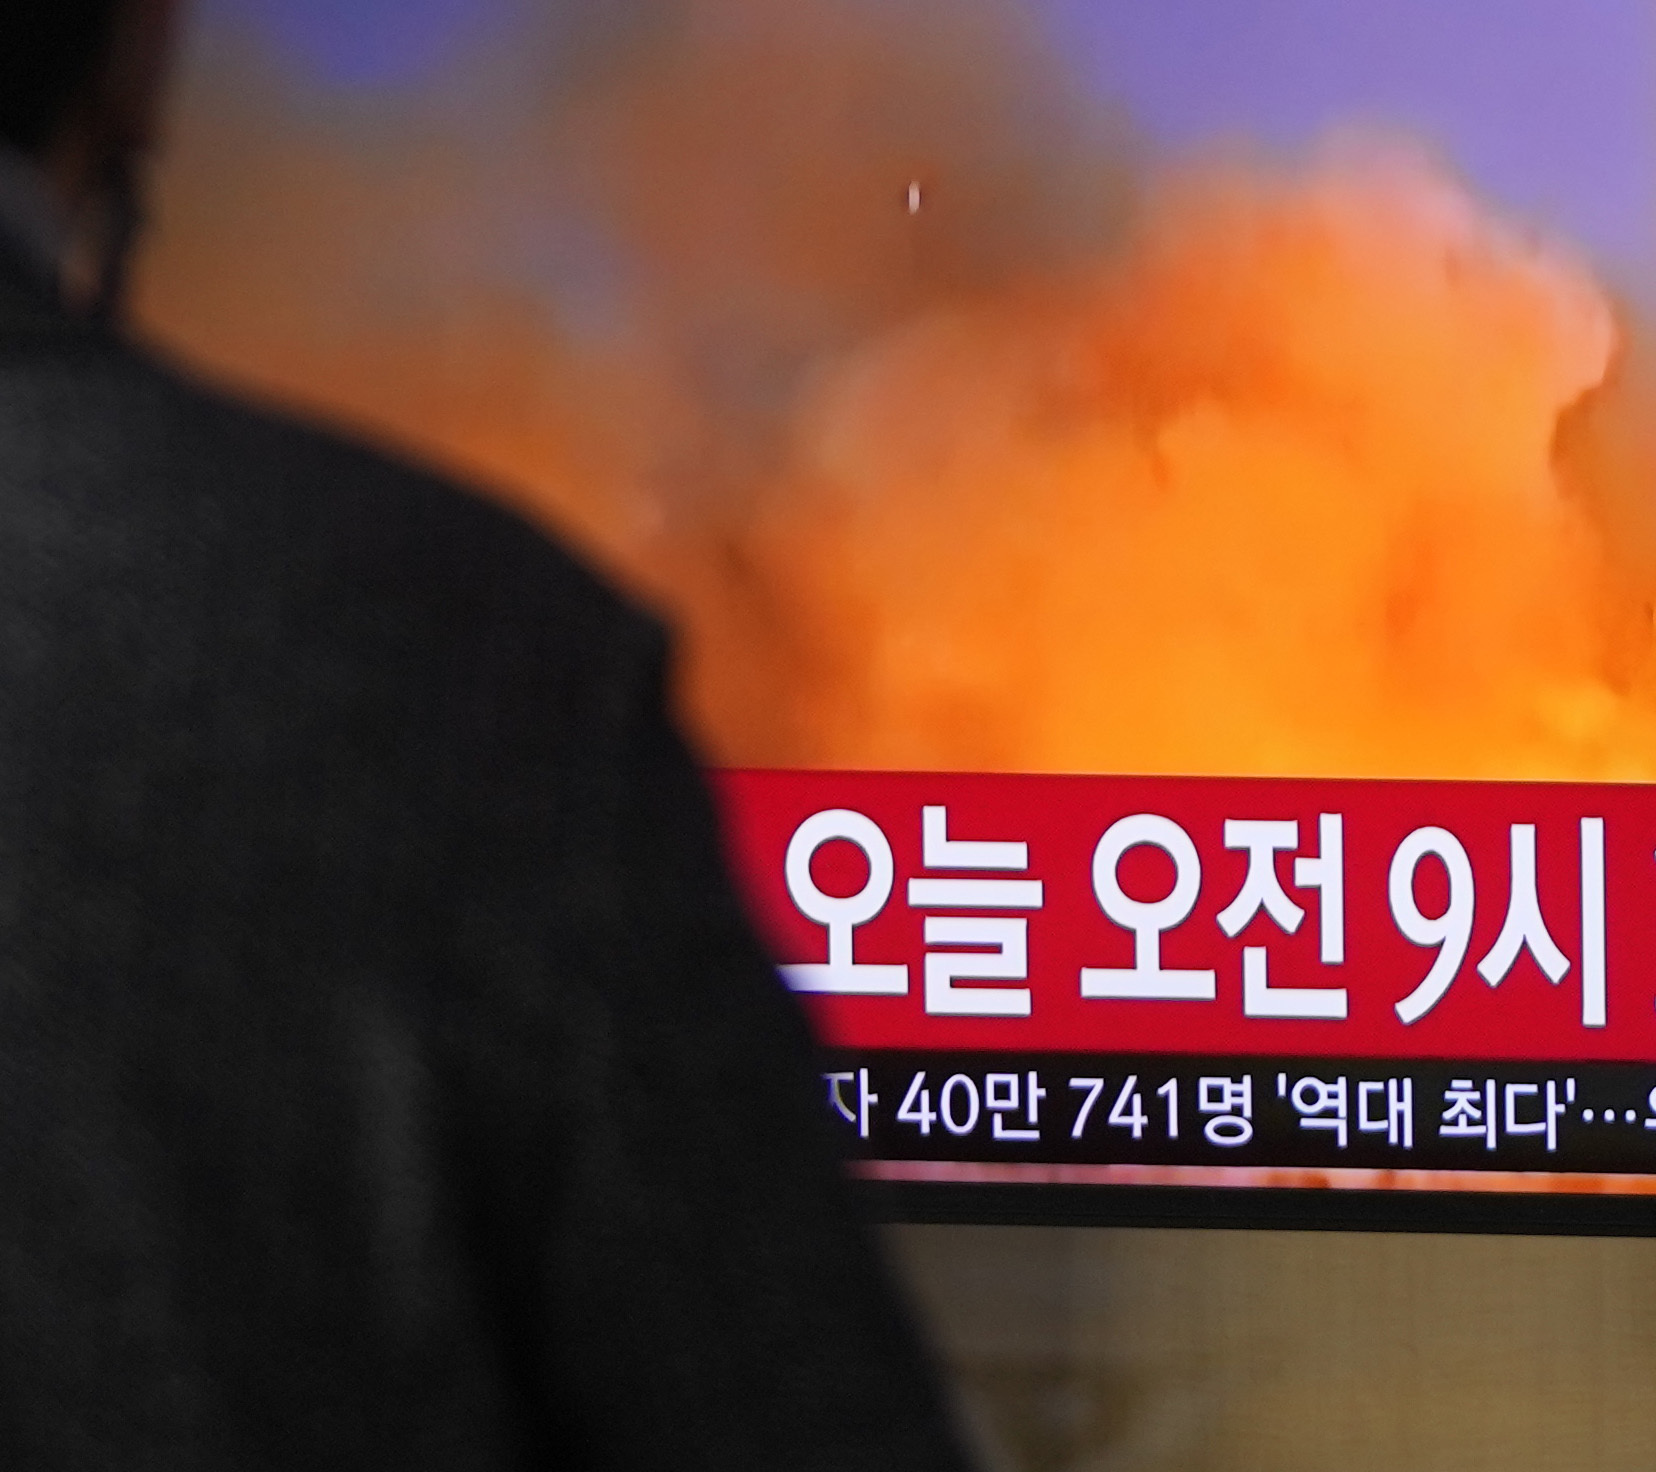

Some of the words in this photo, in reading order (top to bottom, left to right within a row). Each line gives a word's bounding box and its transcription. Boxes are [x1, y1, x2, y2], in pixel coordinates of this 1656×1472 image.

[784, 804, 1044, 1018] 오늘
[1079, 812, 1348, 1021] 오전
[1388, 818, 1608, 1030] 9시
[895, 1069, 1047, 1142] 40만
[1068, 1074, 1254, 1150] 741명
[1275, 1072, 1414, 1149] '역대
